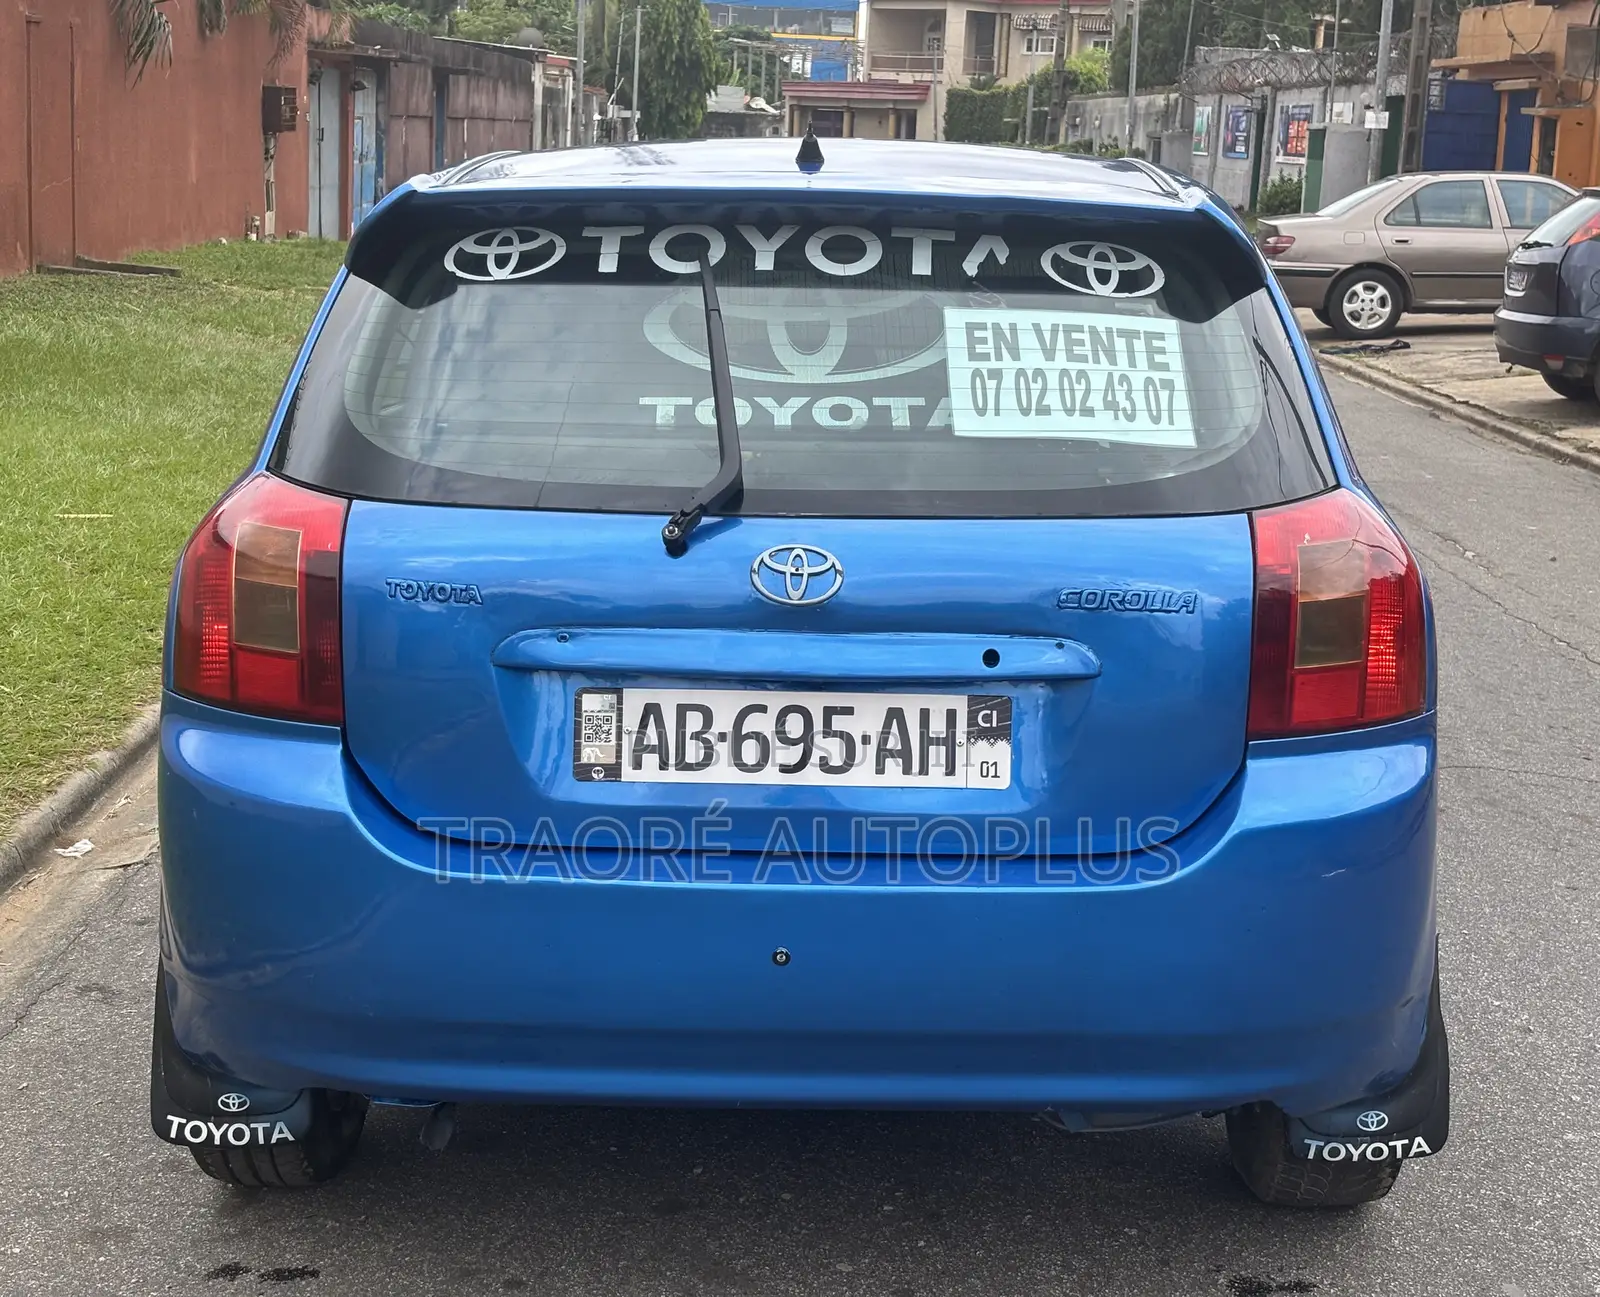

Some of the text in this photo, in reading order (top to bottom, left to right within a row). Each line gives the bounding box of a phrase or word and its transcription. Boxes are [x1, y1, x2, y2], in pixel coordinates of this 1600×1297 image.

[965, 321, 1171, 372] EN VENTE
[970, 367, 1175, 426] 07 02 02 43 07
[384, 577, 484, 606] TOYOTA
[1057, 587, 1198, 614] COROLLA
[977, 709, 998, 728] CI
[980, 760, 1000, 778] 01
[166, 1114, 295, 1146] TOYOTA
[1303, 1136, 1432, 1162] TOYOTA
